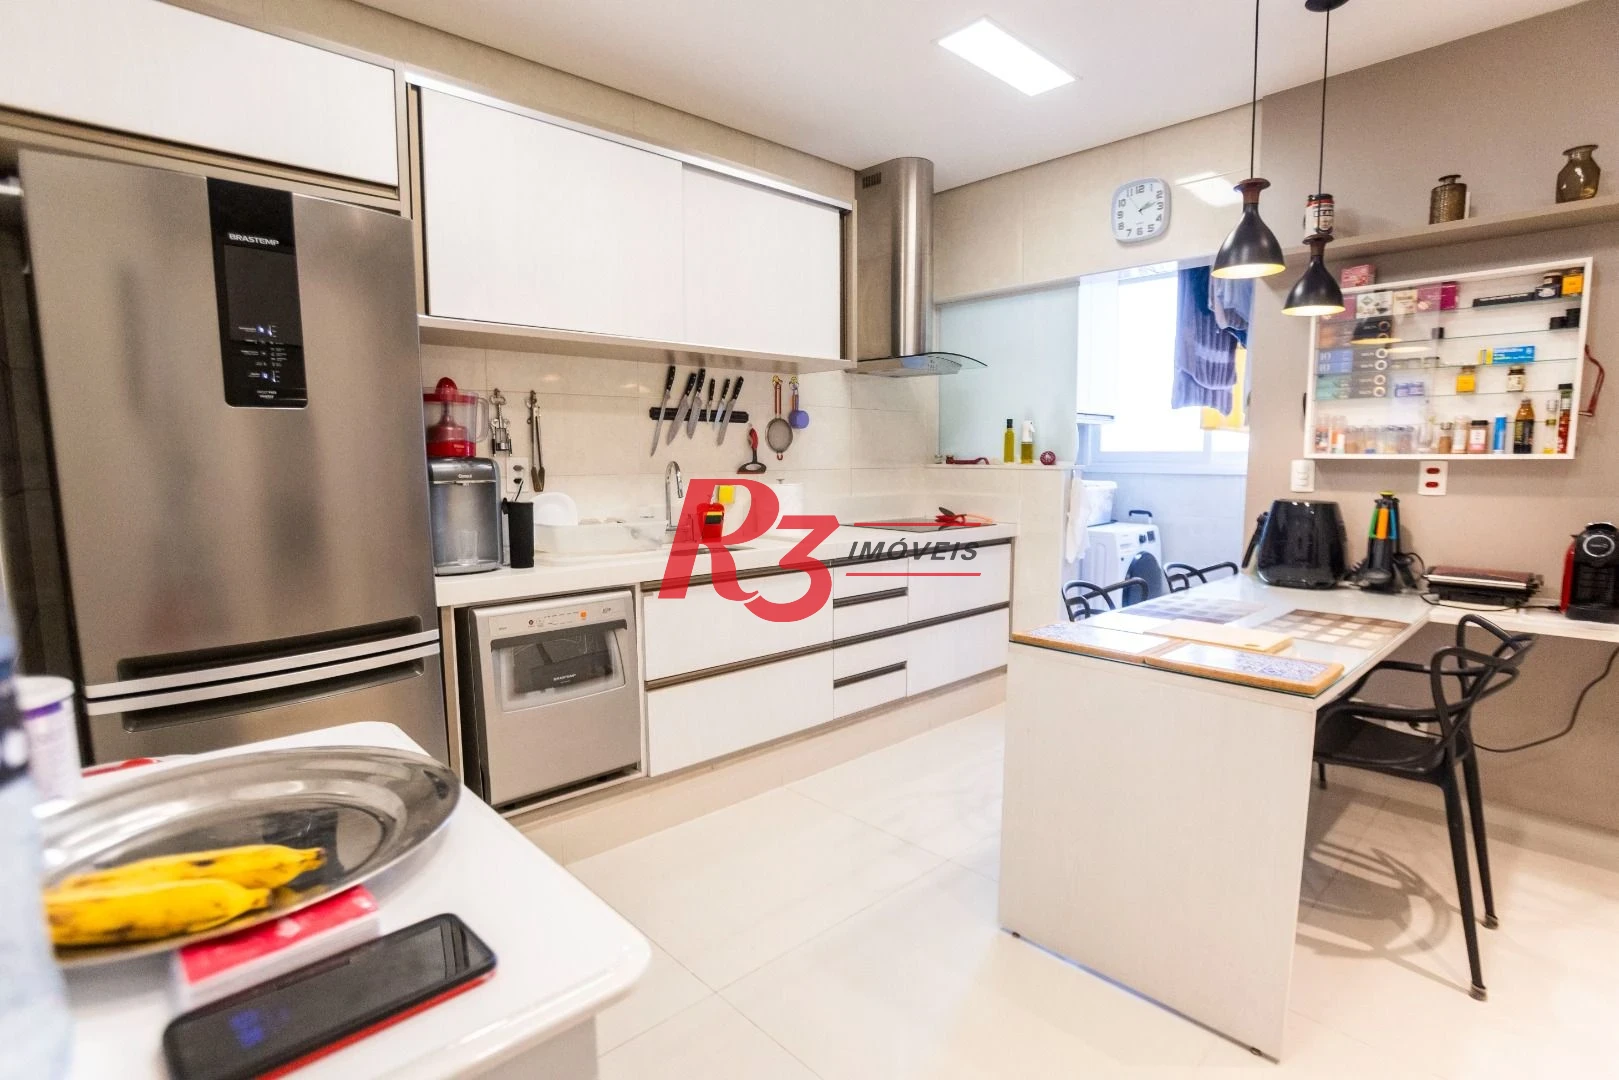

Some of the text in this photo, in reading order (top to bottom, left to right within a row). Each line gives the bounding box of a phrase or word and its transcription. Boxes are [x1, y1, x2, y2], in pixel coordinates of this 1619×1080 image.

[1126, 188, 1133, 198] 11
[1135, 184, 1145, 194] 12
[1156, 190, 1163, 199] 2
[1118, 198, 1127, 208] 10
[1156, 201, 1164, 211] 3
[1117, 210, 1124, 219] 9
[1156, 213, 1162, 222] 4
[1126, 228, 1132, 237] 7
[1136, 227, 1143, 236] 6
[1147, 223, 1155, 233] 5
[228, 232, 280, 246] BRASTEMP
